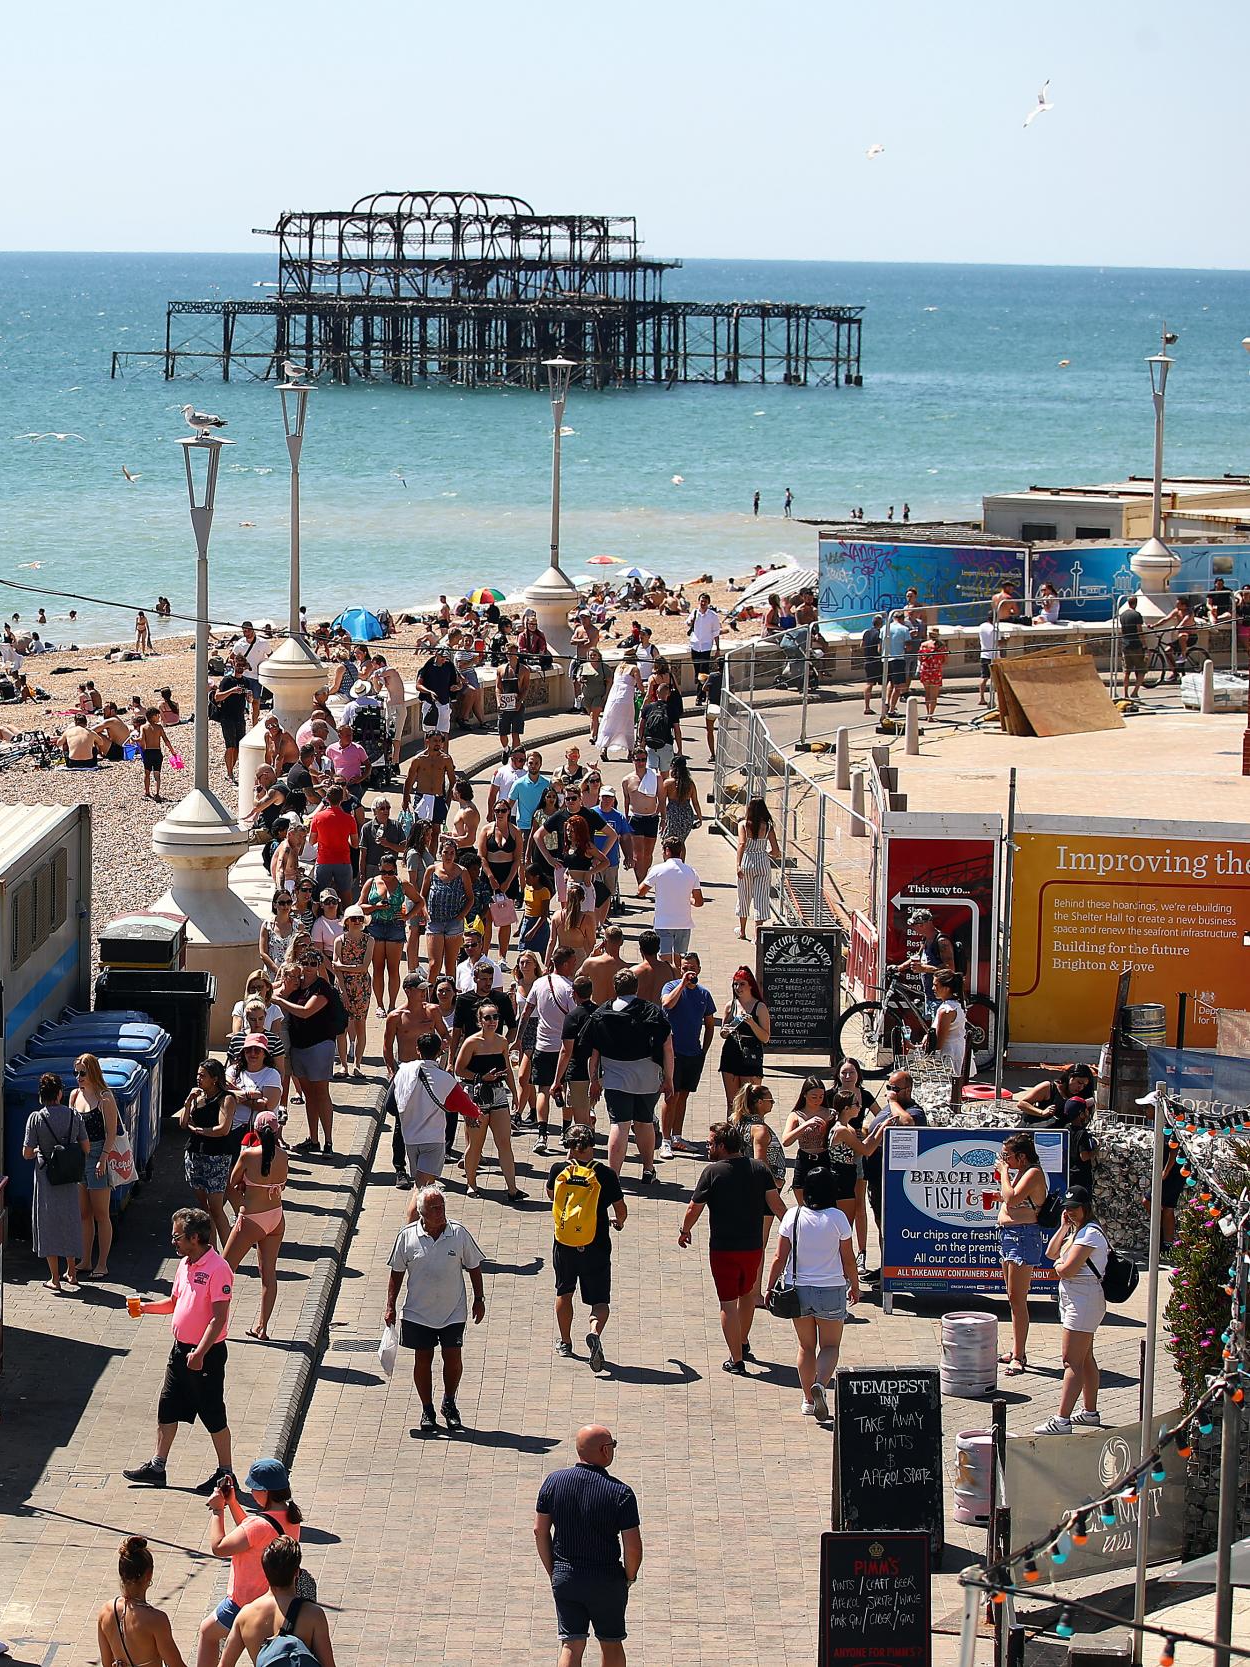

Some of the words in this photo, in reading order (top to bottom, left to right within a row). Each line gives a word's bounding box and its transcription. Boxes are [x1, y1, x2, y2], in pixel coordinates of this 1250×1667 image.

[1056, 846, 1209, 879] Improving
[907, 884, 930, 894] This
[931, 886, 952, 896] way
[952, 885, 970, 894] to...
[1054, 898, 1085, 909] Behind
[1087, 899, 1111, 909] these
[1112, 900, 1159, 913] hoardings,
[1160, 903, 1186, 911] we're
[1187, 902, 1232, 915] rebuilding
[1054, 911, 1069, 921] the
[1071, 911, 1103, 922] Shelter
[1105, 913, 1123, 922] Hall
[1125, 914, 1135, 923] to
[1137, 915, 1166, 924] create
[1167, 916, 1174, 924] a
[1176, 917, 1196, 925] new
[1198, 915, 1237, 926] business
[1053, 925, 1078, 935] space
[1079, 925, 1096, 934] and
[1098, 927, 1126, 935] renew
[1128, 926, 1142, 935] the
[1143, 927, 1179, 937] seafront
[1180, 928, 1240, 939] infrastructure.
[801, 934, 815, 946] OF
[813, 942, 832, 966] WAR
[1053, 940, 1107, 955] Building
[1108, 941, 1126, 953] for
[1129, 942, 1149, 955] the
[1151, 943, 1190, 956] future
[1052, 957, 1107, 972] Brighton
[1109, 960, 1120, 970] &
[1122, 960, 1155, 972] Hove
[1198, 1016, 1210, 1025] for
[910, 1170, 973, 1185] BEACH
[924, 1186, 963, 1210] FISH
[966, 1188, 983, 1210] &
[901, 1228, 922, 1239] Our
[923, 1229, 950, 1241] chips
[951, 1232, 968, 1240] are
[935, 1243, 948, 1252] on
[949, 1242, 966, 1252] the
[968, 1243, 1003, 1254] premis
[914, 1252, 927, 1263] All
[928, 1255, 947, 1263] our
[948, 1253, 964, 1264] cod
[969, 1254, 977, 1264] is
[979, 1254, 997, 1264] line
[910, 1269, 947, 1277] TAKEAWAY
[947, 1270, 989, 1278] CONTAINERS
[850, 1380, 930, 1395] TEMPEST
[880, 1395, 899, 1406] INN
[853, 1415, 886, 1434] TAKE
[892, 1411, 924, 1430] AWAY
[875, 1434, 914, 1451] PINTS
[859, 1468, 903, 1489] APEROL
[853, 1558, 900, 1575] PIMM'S
[832, 1579, 855, 1592] PINTS
[894, 1575, 916, 1590] BEER
[831, 1596, 860, 1610] APEROL
[899, 1593, 922, 1606] WINE
[830, 1613, 847, 1629] PINK
[869, 1612, 893, 1626] CIDER
[833, 1647, 867, 1658] ANYONE
[869, 1648, 885, 1657] FOR
